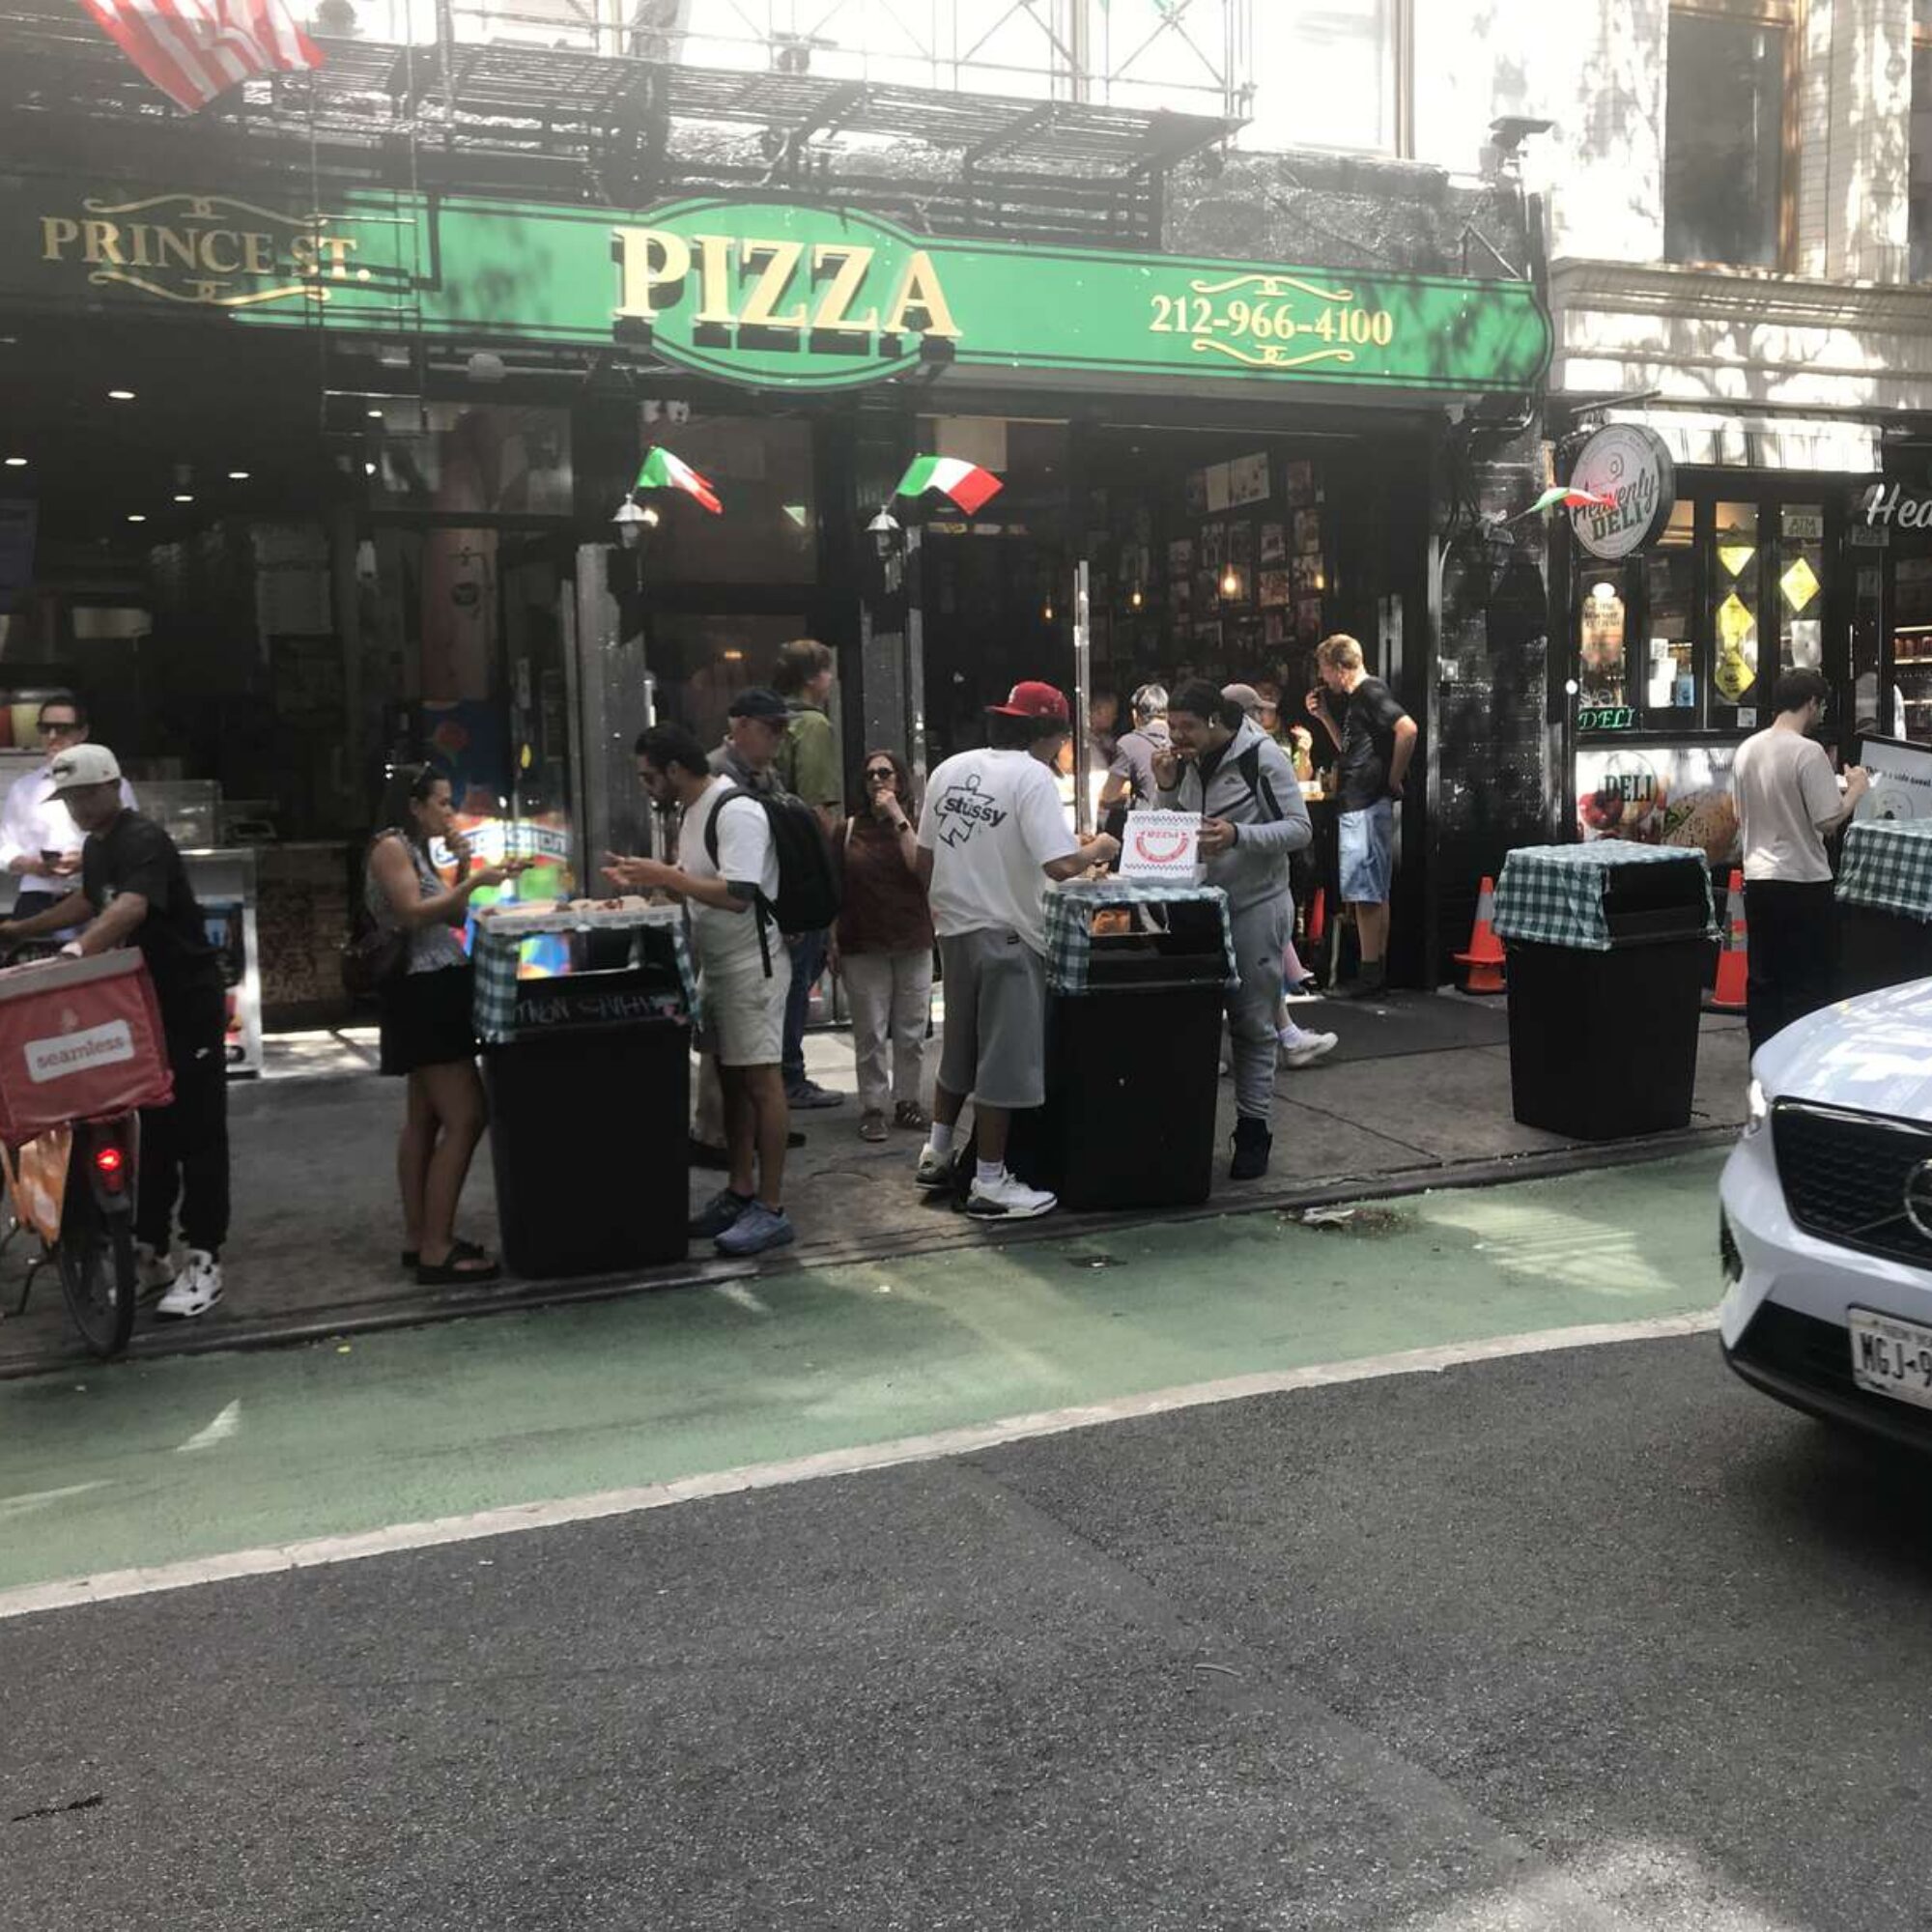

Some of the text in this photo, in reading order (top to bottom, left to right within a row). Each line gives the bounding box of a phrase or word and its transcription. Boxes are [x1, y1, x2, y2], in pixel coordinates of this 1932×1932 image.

[40, 216, 371, 281] PRINCE ST.
[612, 225, 963, 337] PIZZA
[1150, 294, 1393, 346] 212-966-4100
[1592, 500, 1644, 542] DELI
[1866, 482, 1932, 528] Hea
[1578, 707, 1635, 730] DELI
[1604, 774, 1653, 803] DELI
[37, 1035, 126, 1068] seamless
